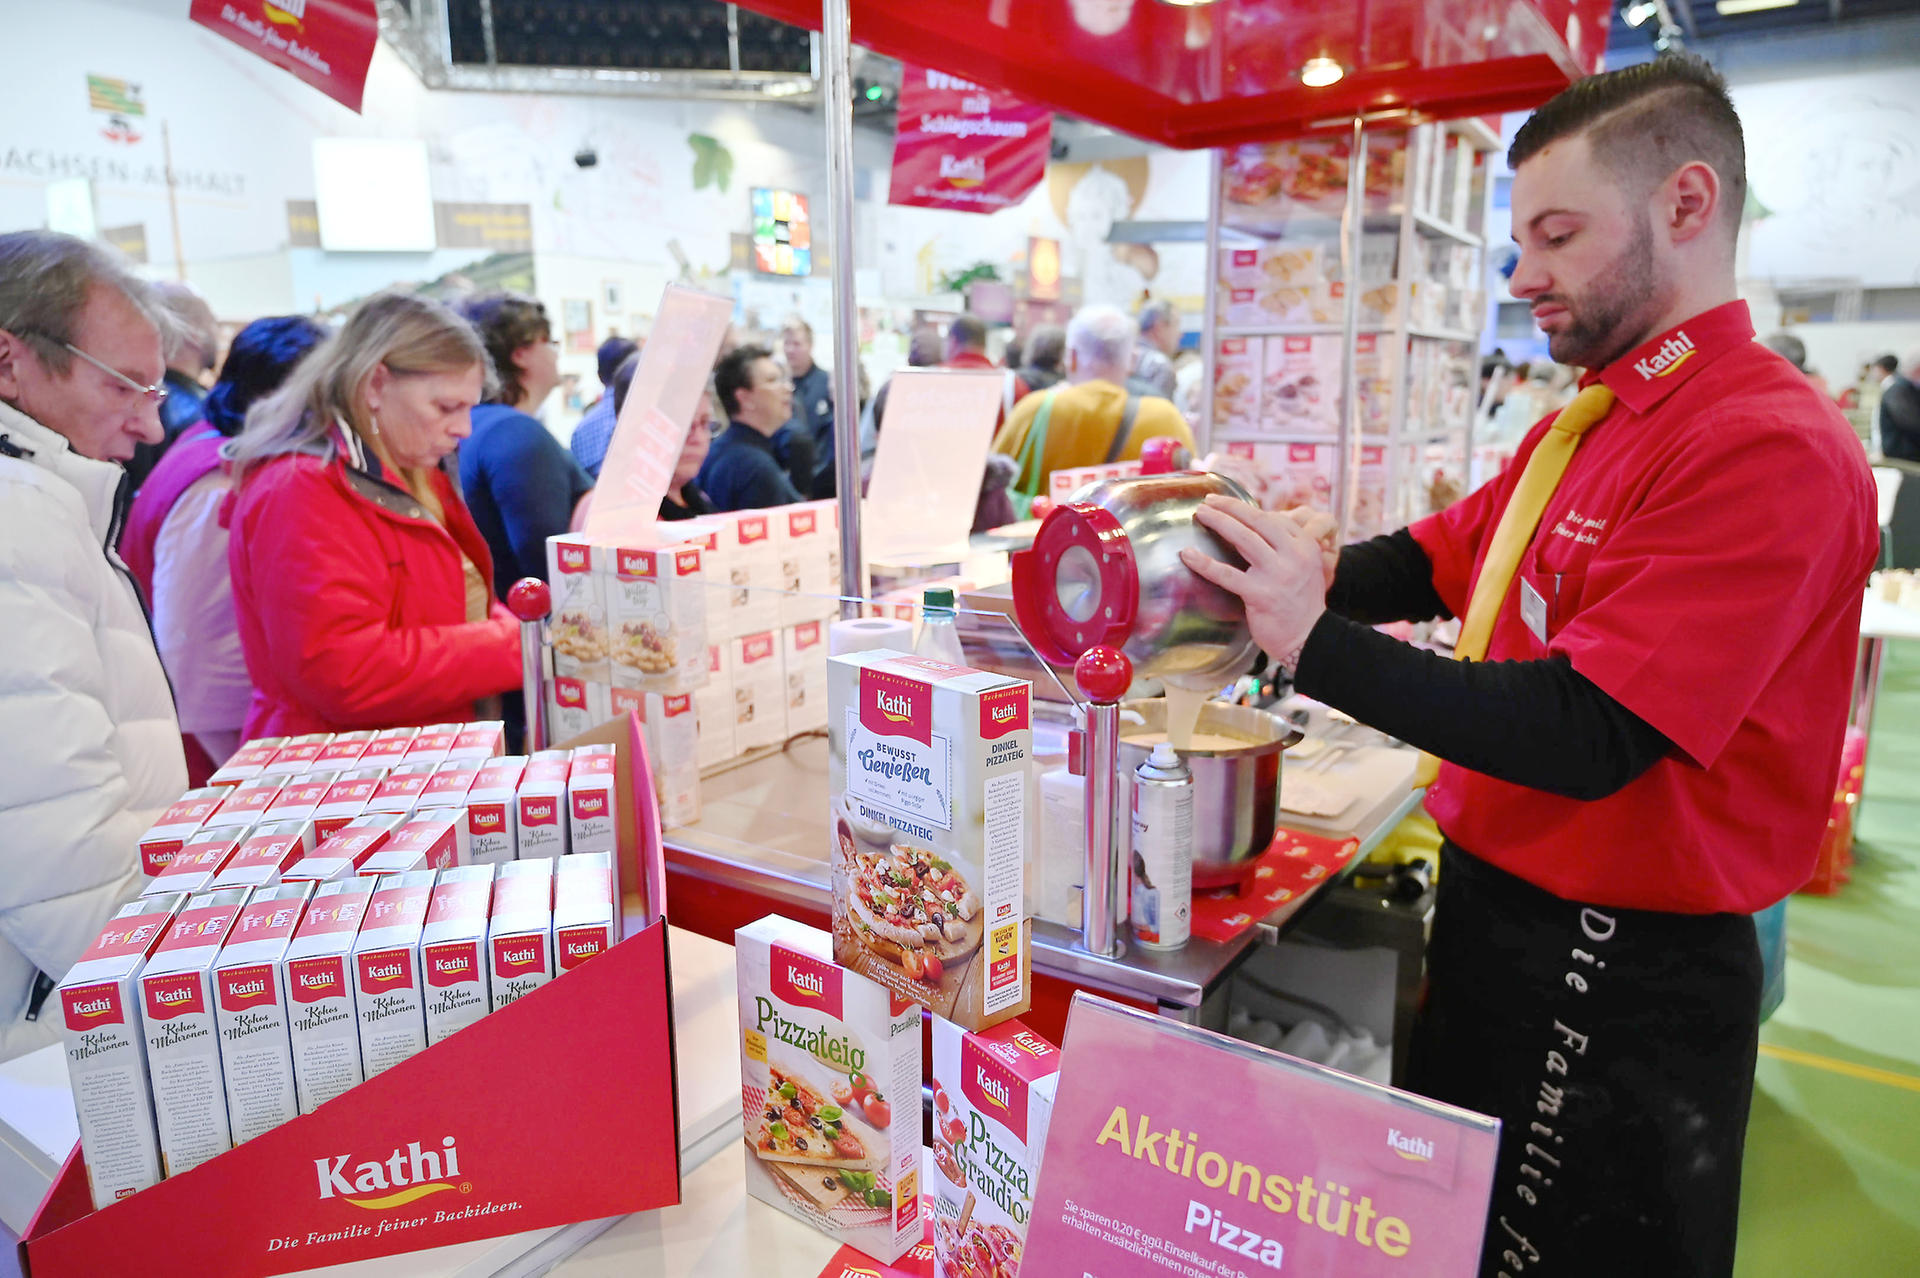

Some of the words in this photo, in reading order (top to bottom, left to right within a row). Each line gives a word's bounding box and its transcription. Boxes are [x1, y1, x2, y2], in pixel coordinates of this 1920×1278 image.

[962, 93, 990, 114] mit
[1633, 330, 1695, 381] Kathi
[624, 556, 649, 571] Kathi
[876, 689, 912, 718] Kathi
[992, 703, 1017, 720] Kathi
[876, 742, 917, 762] BEWUSST
[985, 749, 1024, 767] PIZZATEIG
[992, 739, 1018, 754] DINKEL
[857, 749, 933, 786] Genießen
[526, 805, 551, 816] Kathi
[579, 798, 603, 809] Kathi
[474, 813, 499, 824] Kathi
[859, 804, 888, 825] DINKEL
[888, 815, 933, 841] PIZZATEIG
[503, 949, 535, 963] Kathi
[567, 940, 599, 954] Kathi
[1565, 907, 1617, 993] Die
[368, 963, 402, 978] Kathi
[435, 957, 470, 971] Kathi
[228, 979, 265, 996] Kathi
[299, 971, 335, 987] Kathi
[787, 965, 823, 994] Kathi
[72, 998, 112, 1015] Kathi
[155, 987, 193, 1004] Kathi
[755, 996, 867, 1088] Pizzateig
[1013, 1031, 1054, 1057] Kathi
[976, 1064, 1010, 1108] Kathi
[1516, 1019, 1590, 1205] Familie
[969, 1110, 1030, 1201] Pizza
[1387, 1127, 1434, 1159] Kathi
[313, 1135, 461, 1200] Kathi
[1095, 1105, 1413, 1259] Aktionstüte
[267, 1236, 300, 1252] Die
[305, 1224, 372, 1246] Familie
[375, 1215, 428, 1238] feiner
[434, 1200, 523, 1224] Backideen.
[1063, 1199, 1079, 1213] Sie
[1079, 1206, 1112, 1230] sparen
[1111, 1219, 1134, 1238] 0,20
[1141, 1231, 1164, 1251] ggü.
[1163, 1241, 1217, 1271] Einzelkauf
[1216, 1260, 1236, 1278] der
[1184, 1199, 1285, 1270] Pizza
[1061, 1213, 1102, 1238] erhalten
[1102, 1230, 1151, 1259] zusätzlich
[1152, 1252, 1182, 1272] einen
